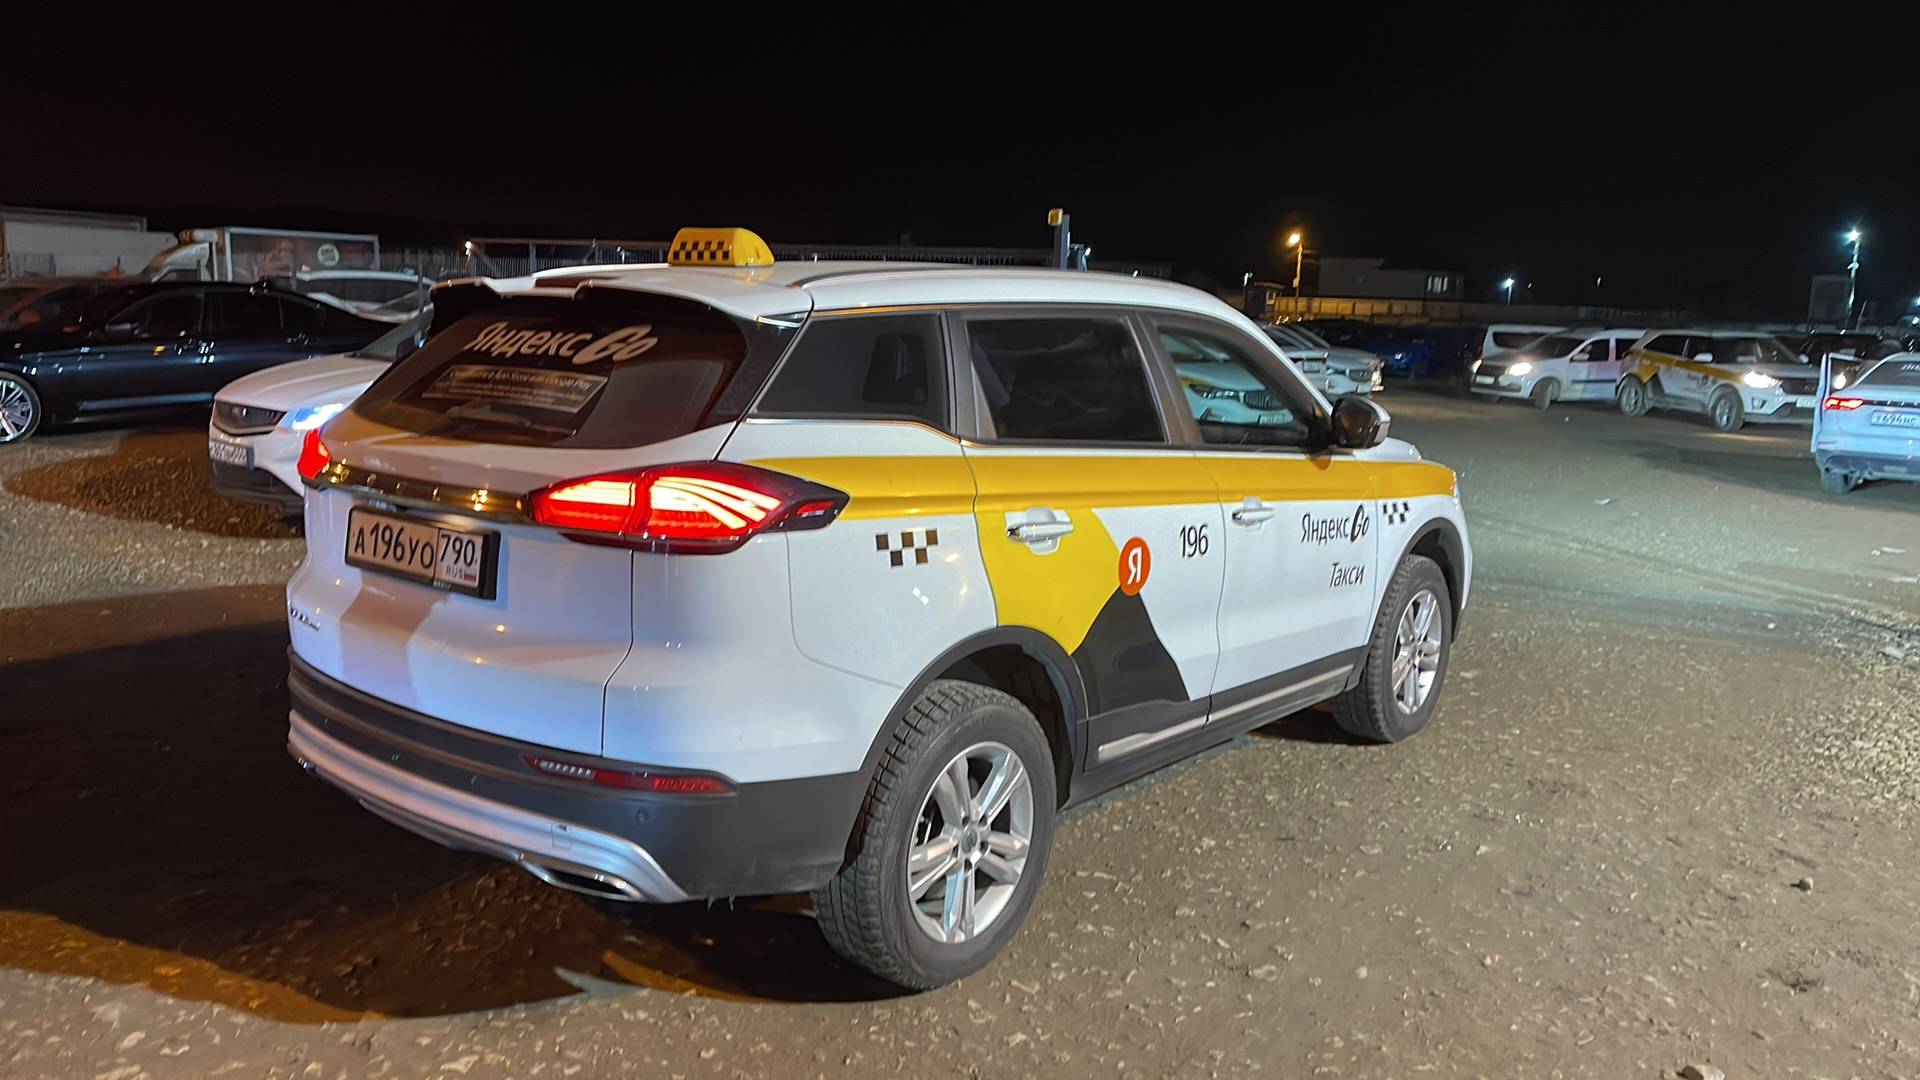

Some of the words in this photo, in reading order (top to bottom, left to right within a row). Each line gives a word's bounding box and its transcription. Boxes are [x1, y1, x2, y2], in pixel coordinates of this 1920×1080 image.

[463, 321, 593, 358] Яндекс
[1180, 524, 1209, 559] 196
[1301, 512, 1350, 546] Яндекс
[1350, 503, 1370, 543] Go
[440, 534, 476, 567] 790
[1127, 546, 1143, 586] Я
[445, 565, 464, 579] RUS
[1329, 561, 1365, 589] Такси
